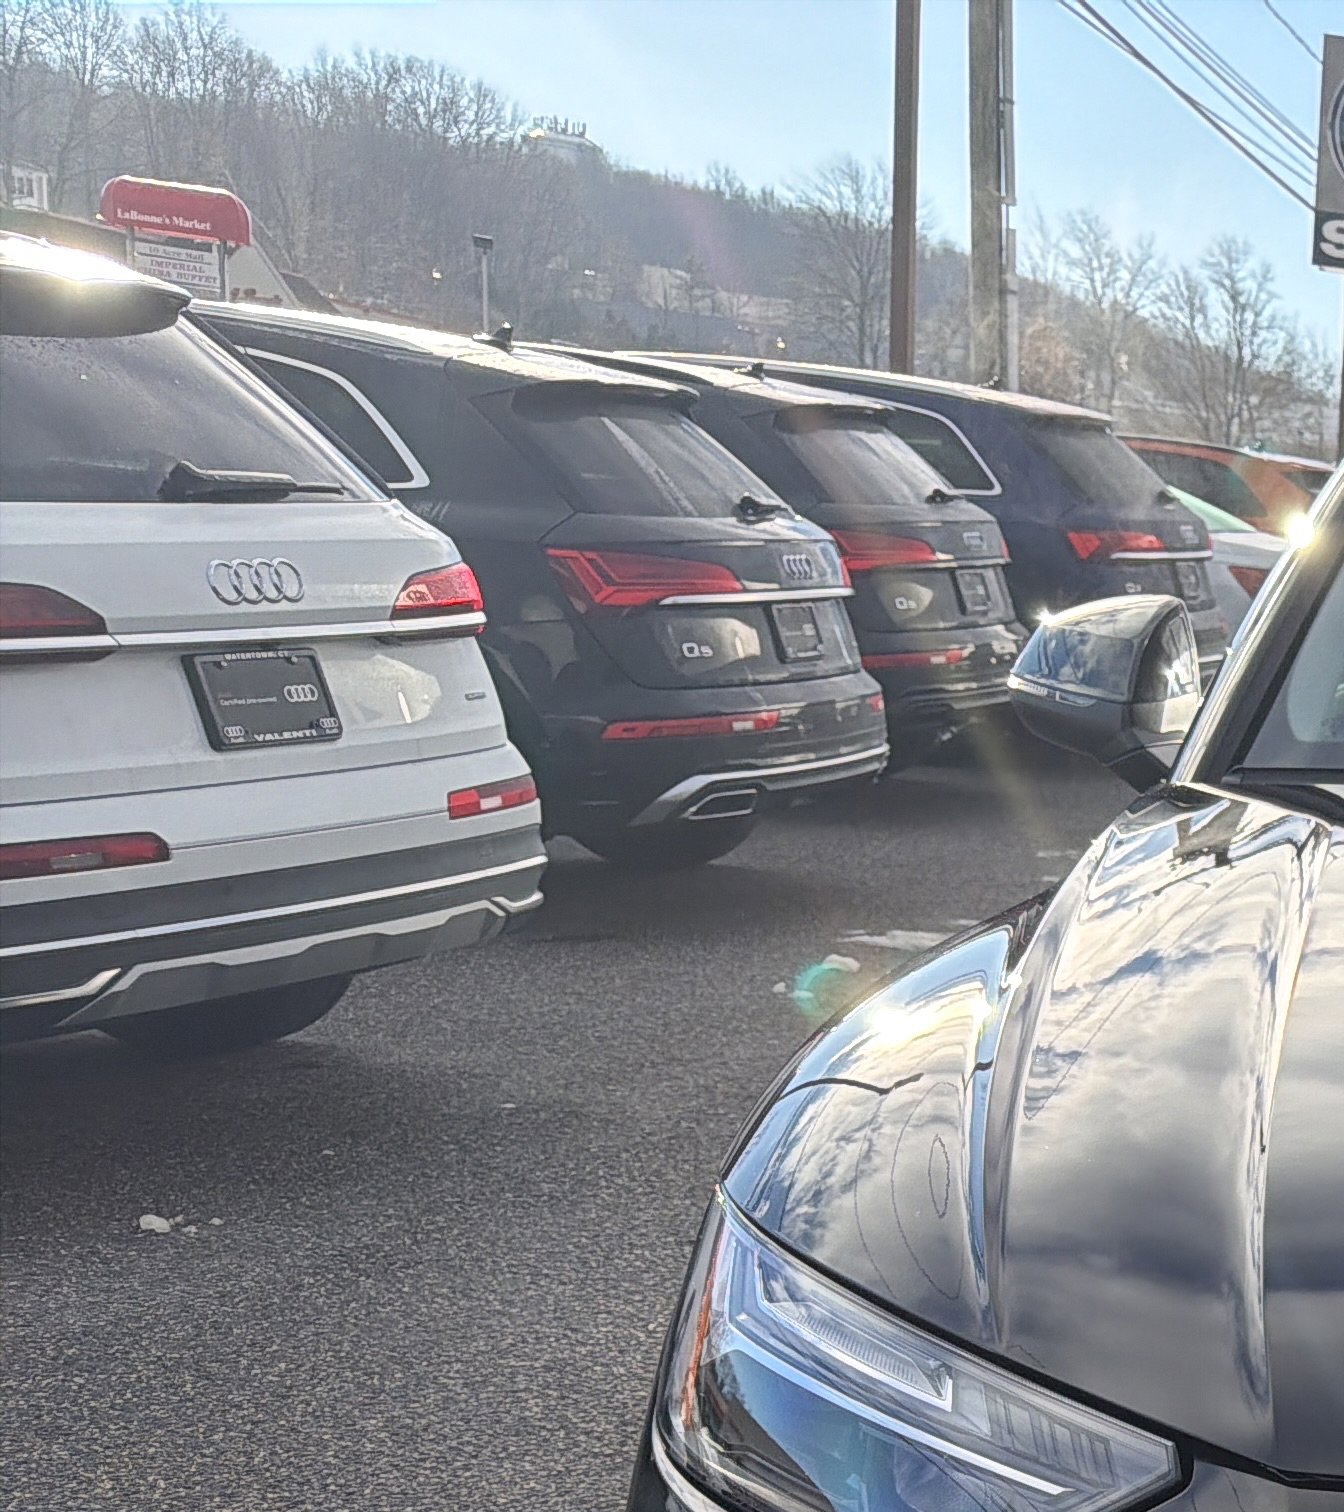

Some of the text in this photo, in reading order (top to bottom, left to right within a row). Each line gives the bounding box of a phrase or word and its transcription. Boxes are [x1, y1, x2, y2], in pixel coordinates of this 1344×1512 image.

[116, 208, 211, 231] LaBonne's Market
[150, 259, 206, 274] IMPERIAL
[176, 271, 218, 285] BUFFET
[682, 642, 714, 658] Q5
[253, 728, 317, 742] VALENTI
